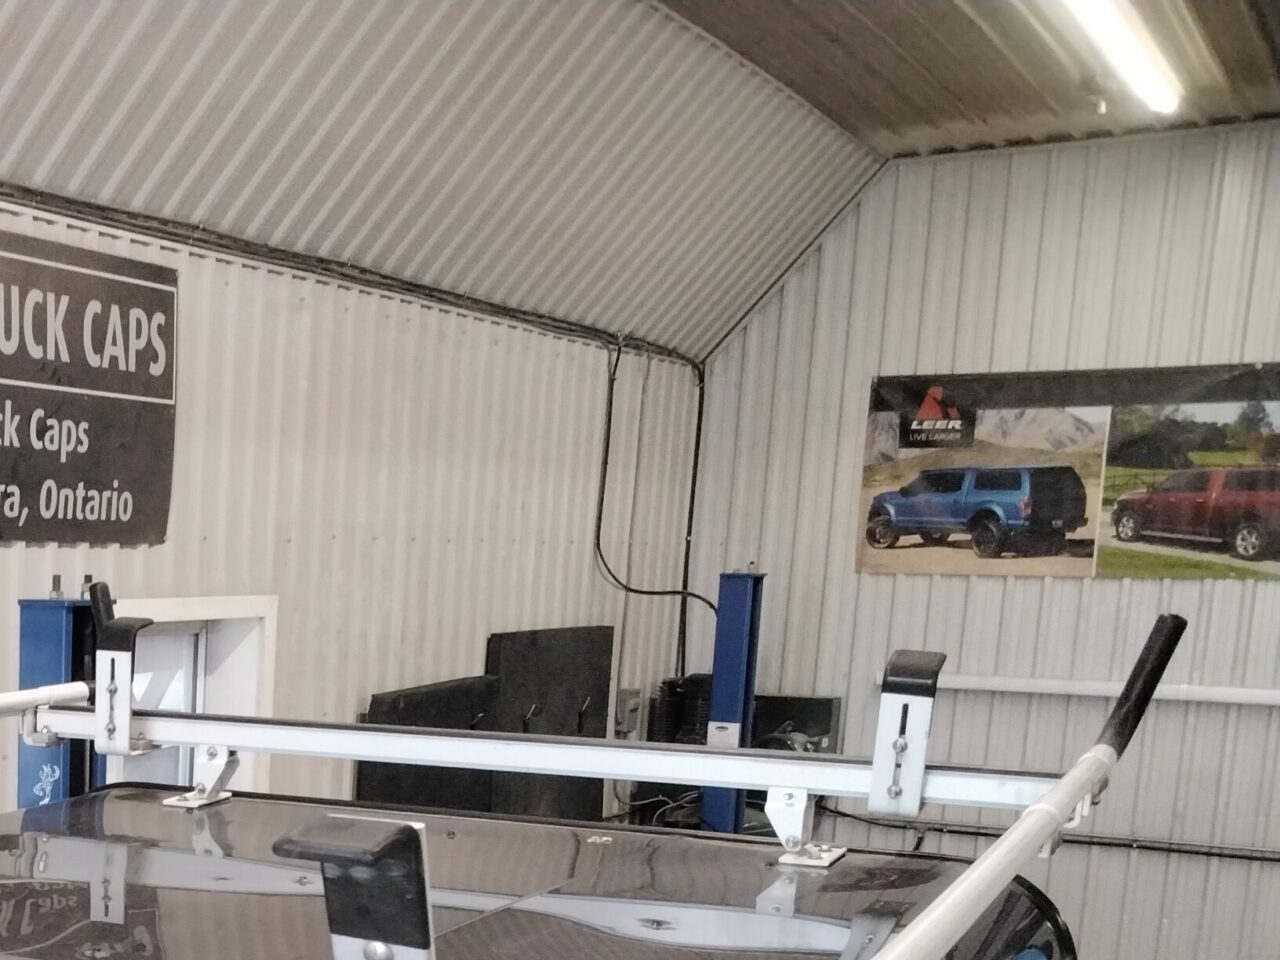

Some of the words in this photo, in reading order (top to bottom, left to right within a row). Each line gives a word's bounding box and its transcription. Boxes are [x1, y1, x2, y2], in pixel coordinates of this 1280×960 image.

[82, 298, 167, 377] CAPS
[29, 407, 89, 463] Caps
[909, 432, 926, 442] LIVE
[910, 419, 963, 430] LEER
[39, 477, 132, 522] Ontario
